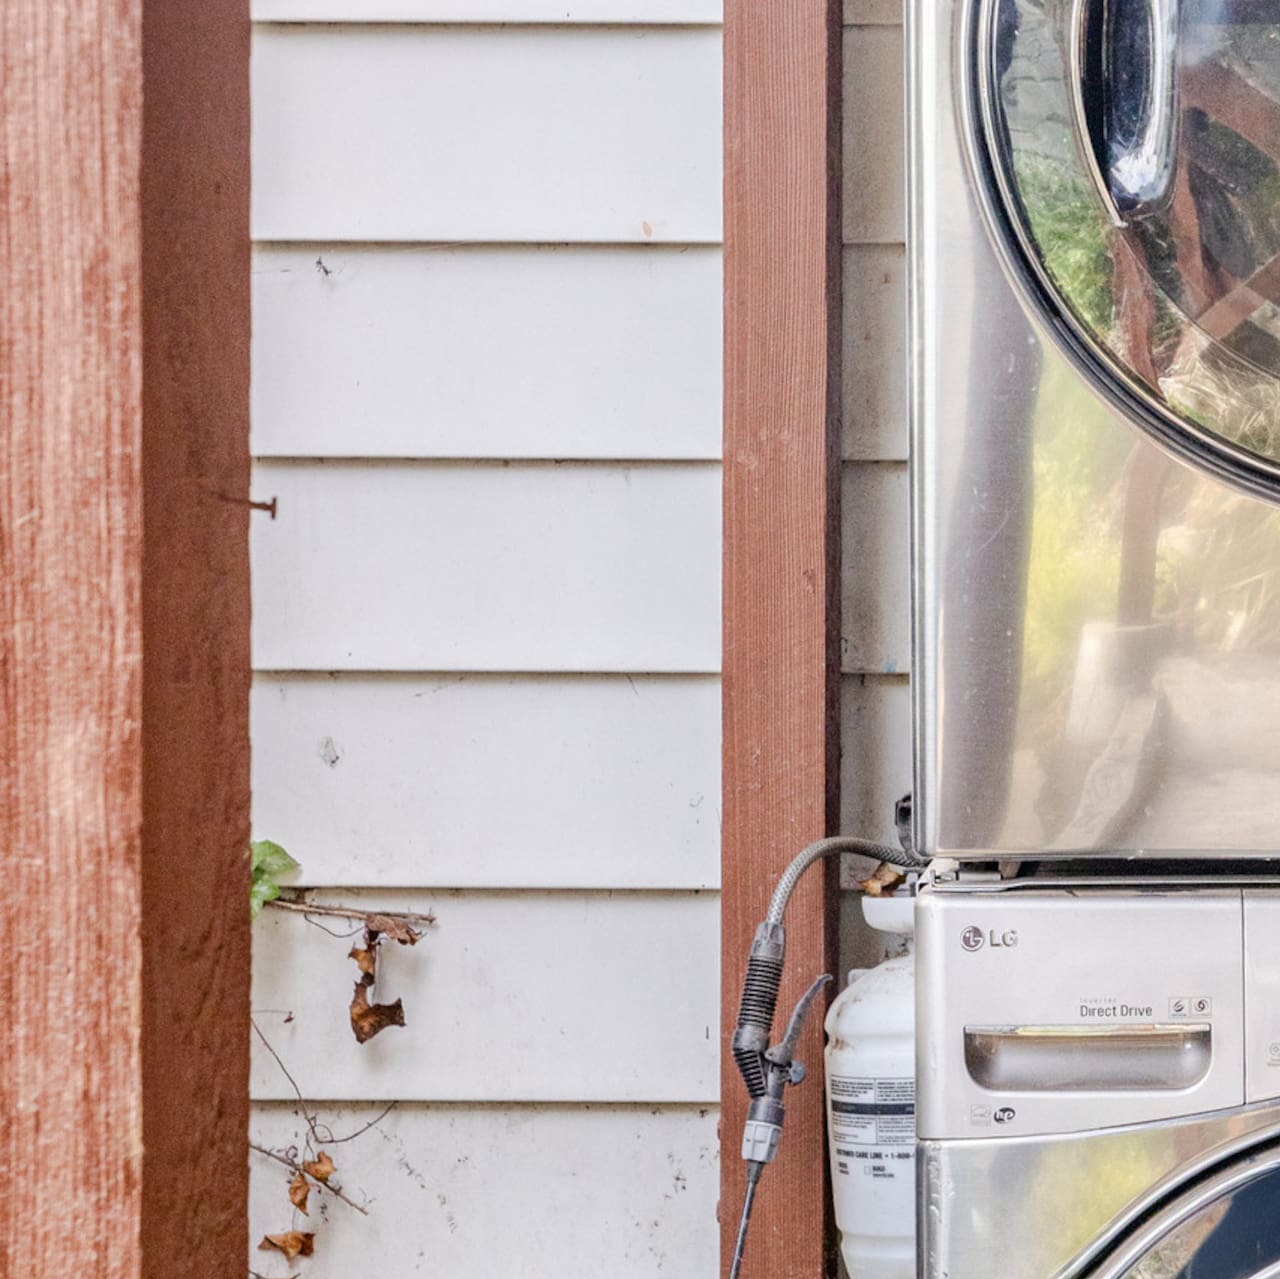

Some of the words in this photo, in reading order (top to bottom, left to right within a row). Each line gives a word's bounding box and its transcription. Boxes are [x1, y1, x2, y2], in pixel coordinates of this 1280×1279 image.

[990, 928, 1018, 947] LG
[1080, 1005, 1117, 1017] Direct
[1120, 1004, 1153, 1017] Drive
[856, 1150, 869, 1160] CARE
[870, 1151, 883, 1160] LINE
